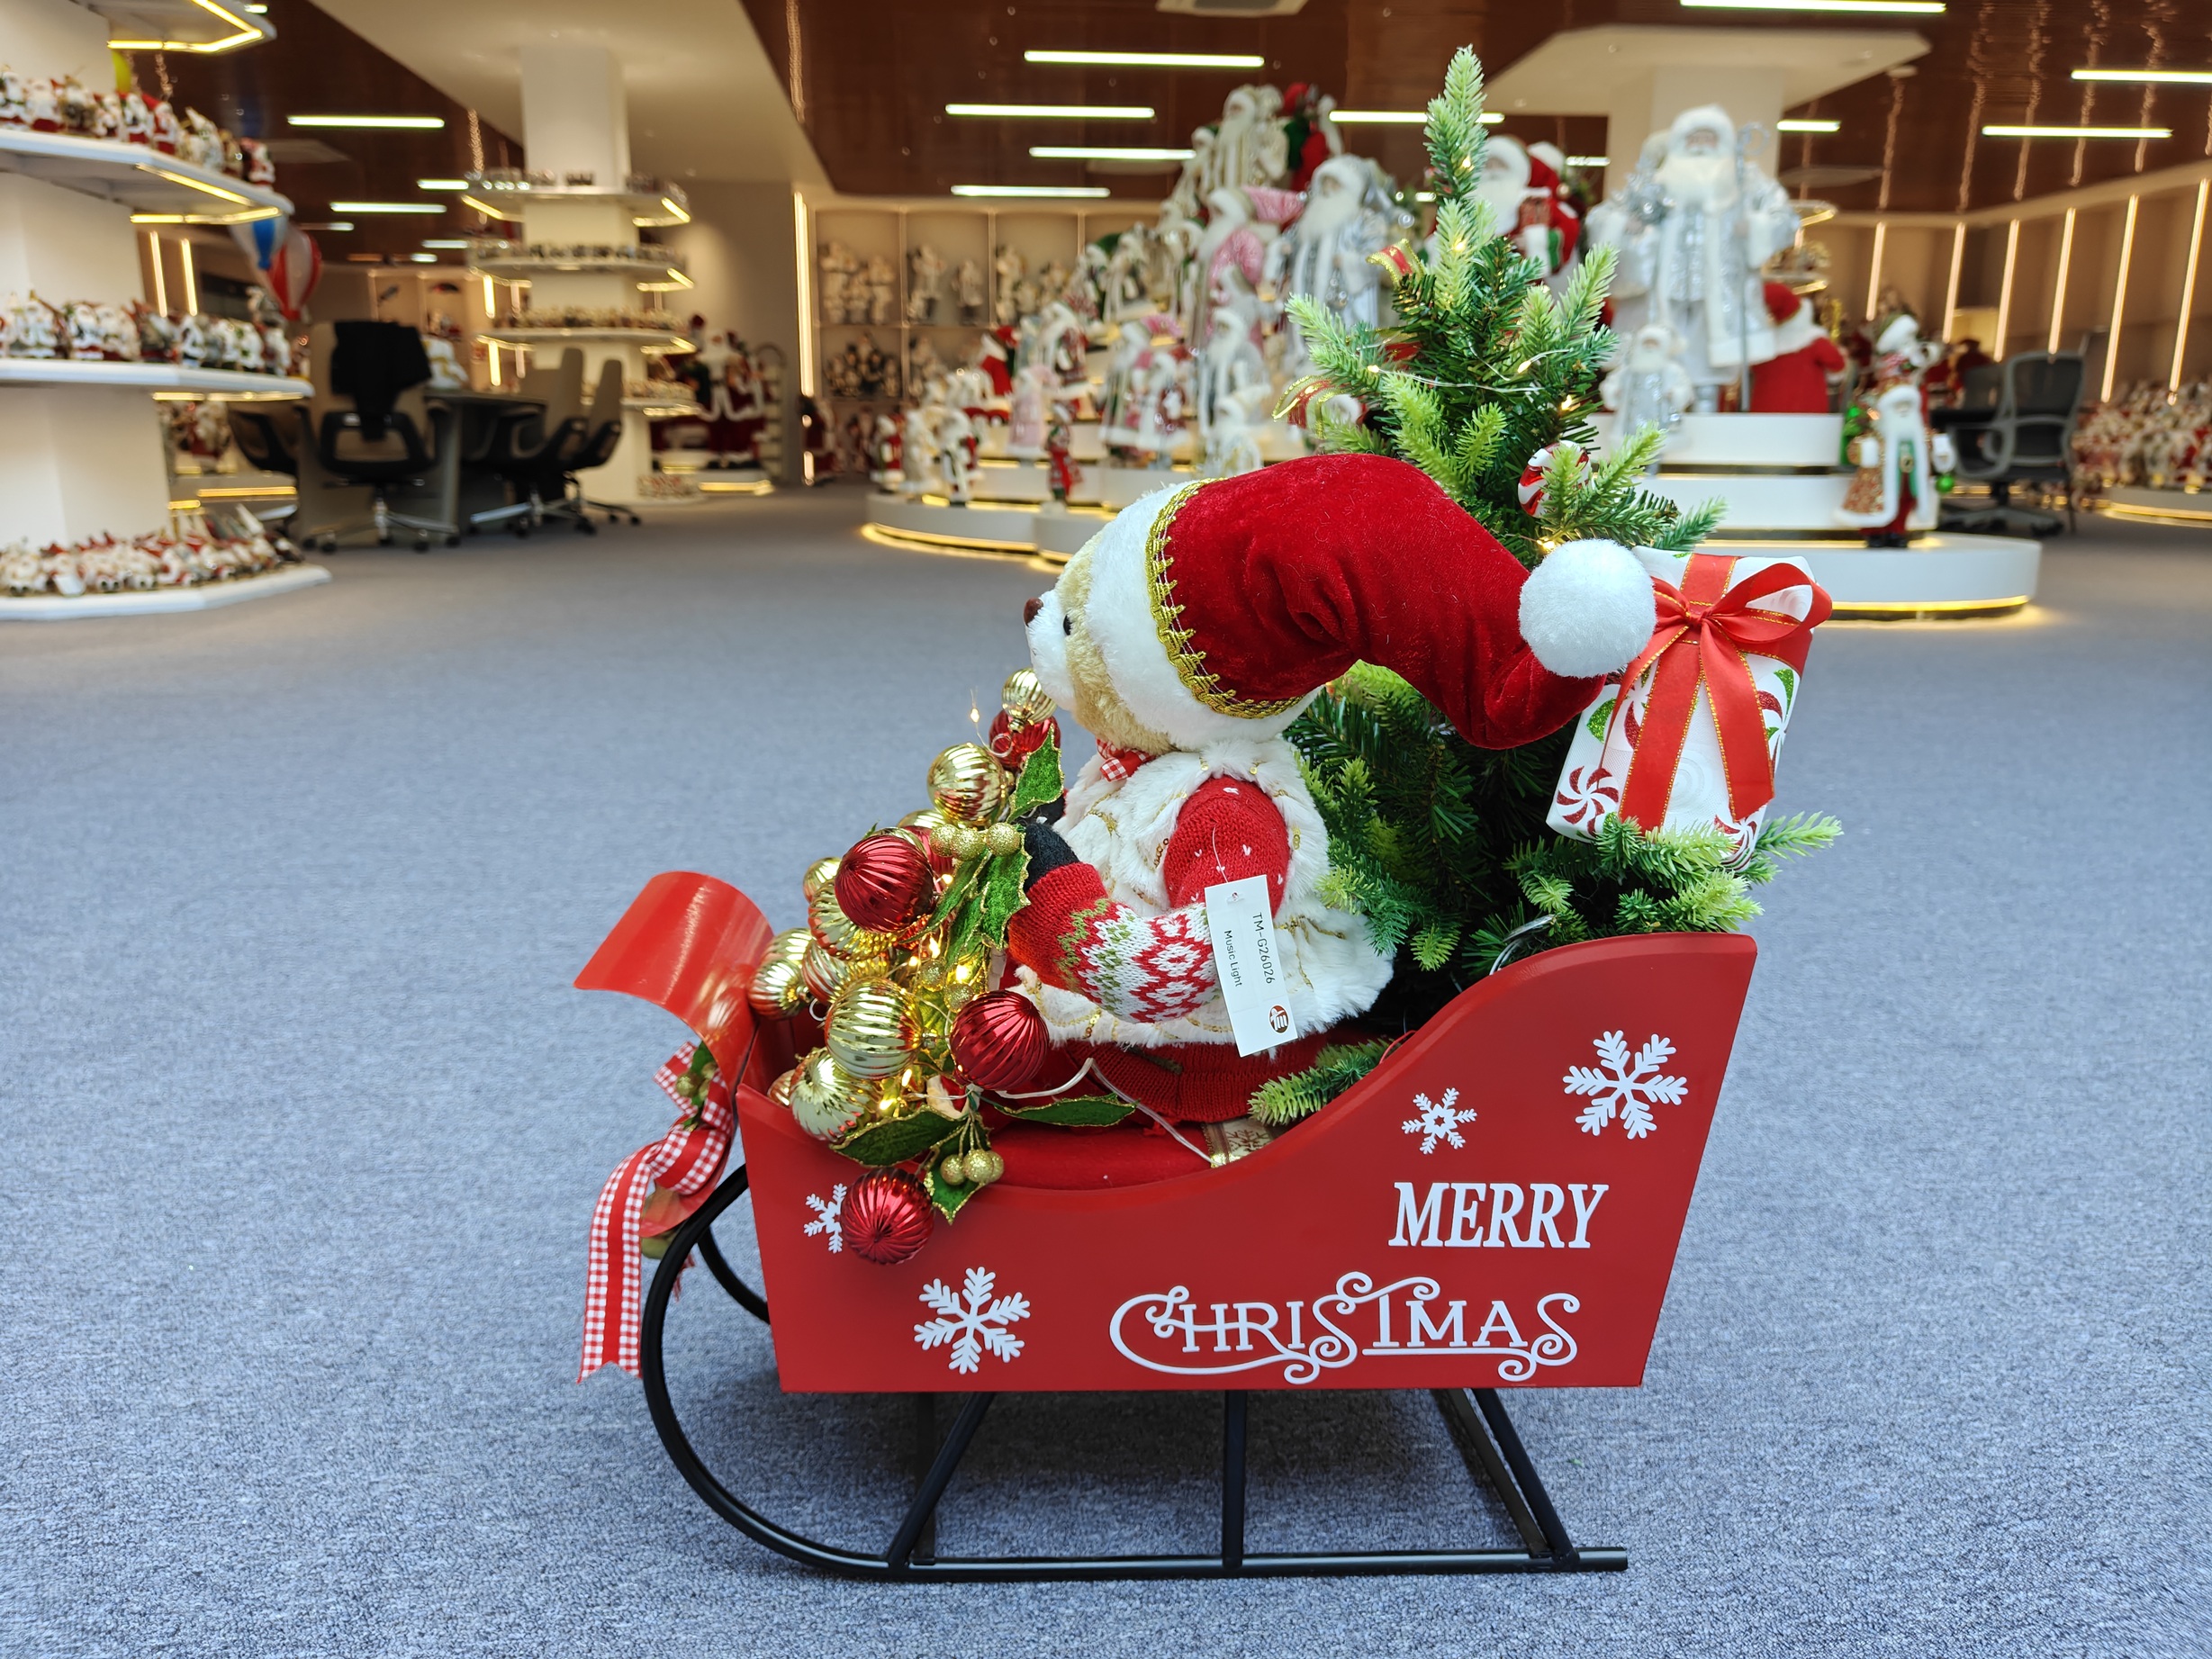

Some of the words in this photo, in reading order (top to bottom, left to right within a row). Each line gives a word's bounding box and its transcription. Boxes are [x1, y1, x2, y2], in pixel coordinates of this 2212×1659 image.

[1223, 930, 1236, 960] Music
[1230, 961, 1242, 987] Light
[1252, 912, 1276, 984] TM-G26026
[1388, 1182, 1609, 1249] MERRY
[1110, 1271, 1580, 1384] CHRISTMAS
